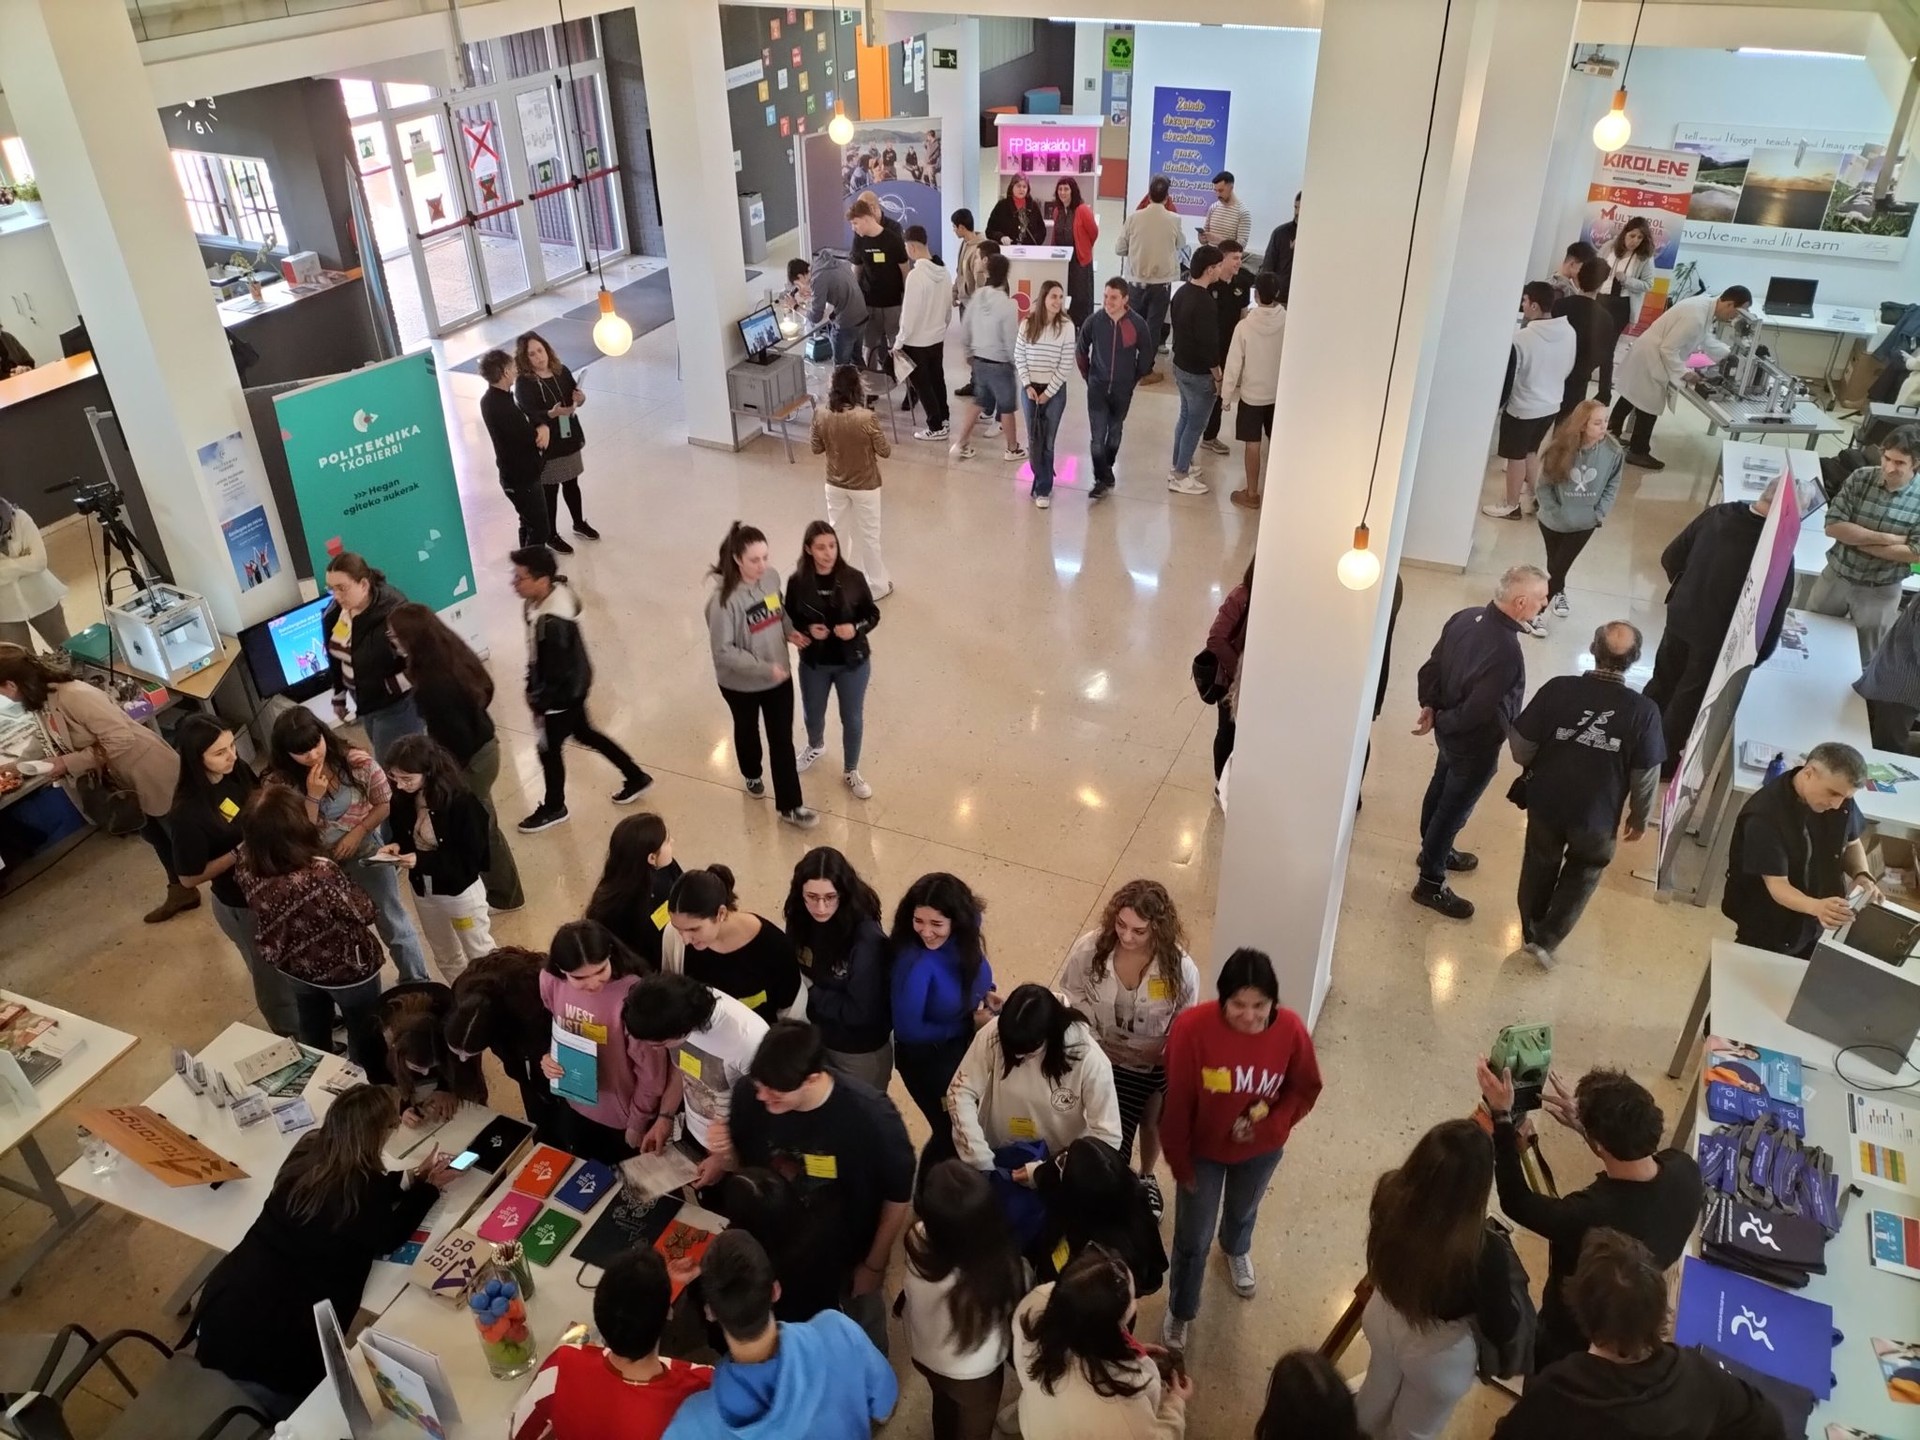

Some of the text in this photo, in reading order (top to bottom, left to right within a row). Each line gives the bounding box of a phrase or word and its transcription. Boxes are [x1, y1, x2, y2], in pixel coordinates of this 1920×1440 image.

[195, 121, 205, 134] 6
[1009, 138, 1024, 153] FP
[1071, 138, 1087, 153] LH
[1603, 152, 1690, 178] KIROLENE
[1637, 191, 1643, 200] 3
[1661, 195, 1668, 204] 3
[1681, 225, 1730, 242] nvolve
[1796, 231, 1840, 251] learn
[318, 424, 421, 469] POLITEKNIKA
[339, 442, 403, 473] TXORIERRI
[343, 482, 420, 516] egiteko aukerak
[368, 479, 401, 496] Hegan
[565, 1003, 595, 1023] WEST
